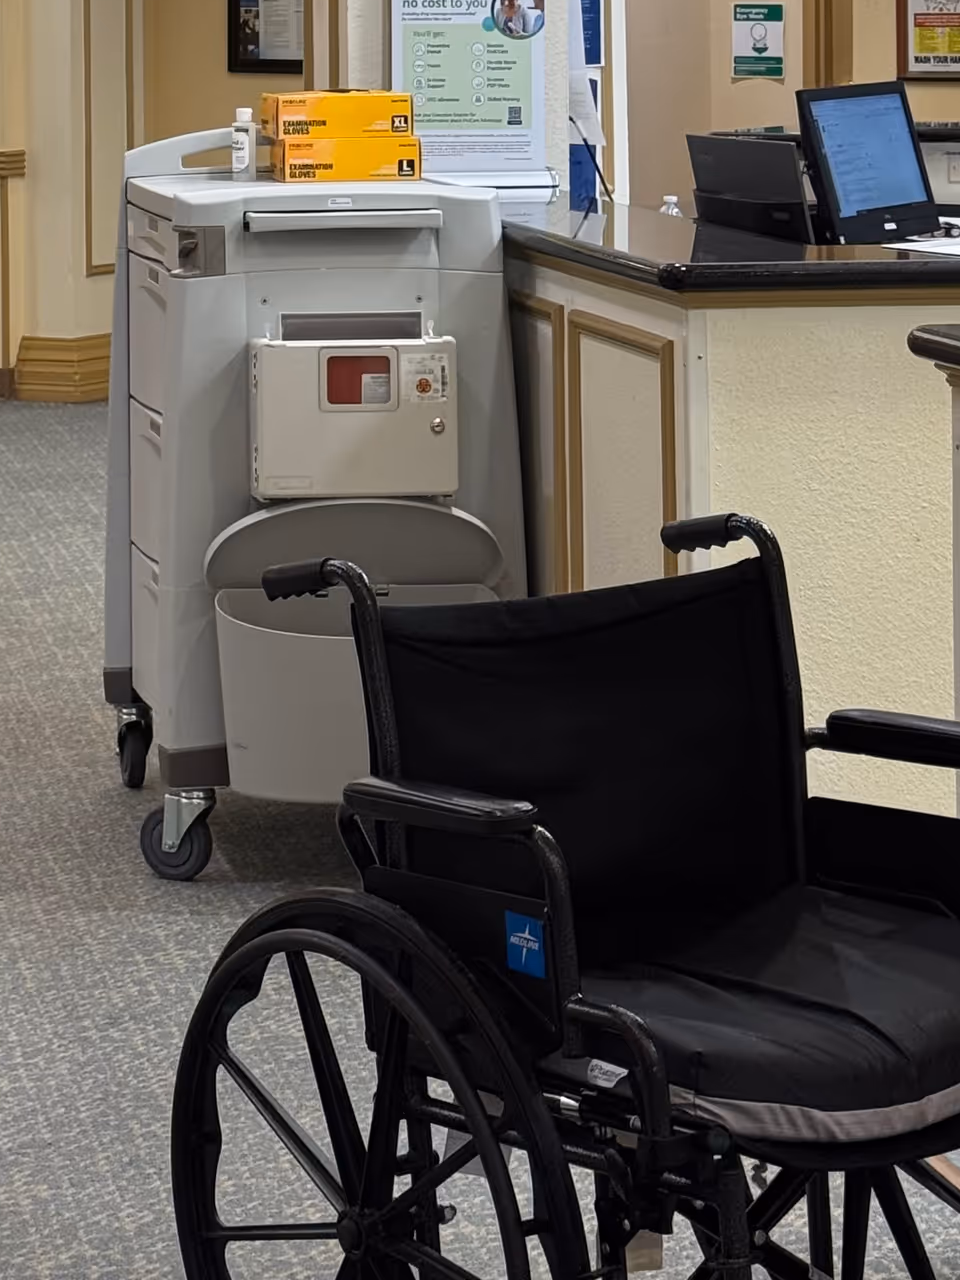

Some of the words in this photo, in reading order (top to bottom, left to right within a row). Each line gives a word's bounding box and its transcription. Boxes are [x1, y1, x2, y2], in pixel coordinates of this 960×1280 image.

[402, 0, 418, 8] no
[465, 0, 488, 10] you
[393, 117, 407, 127] XL
[283, 127, 310, 135] GLOVES
[402, 160, 411, 171] L
[289, 170, 316, 179] GLOVES
